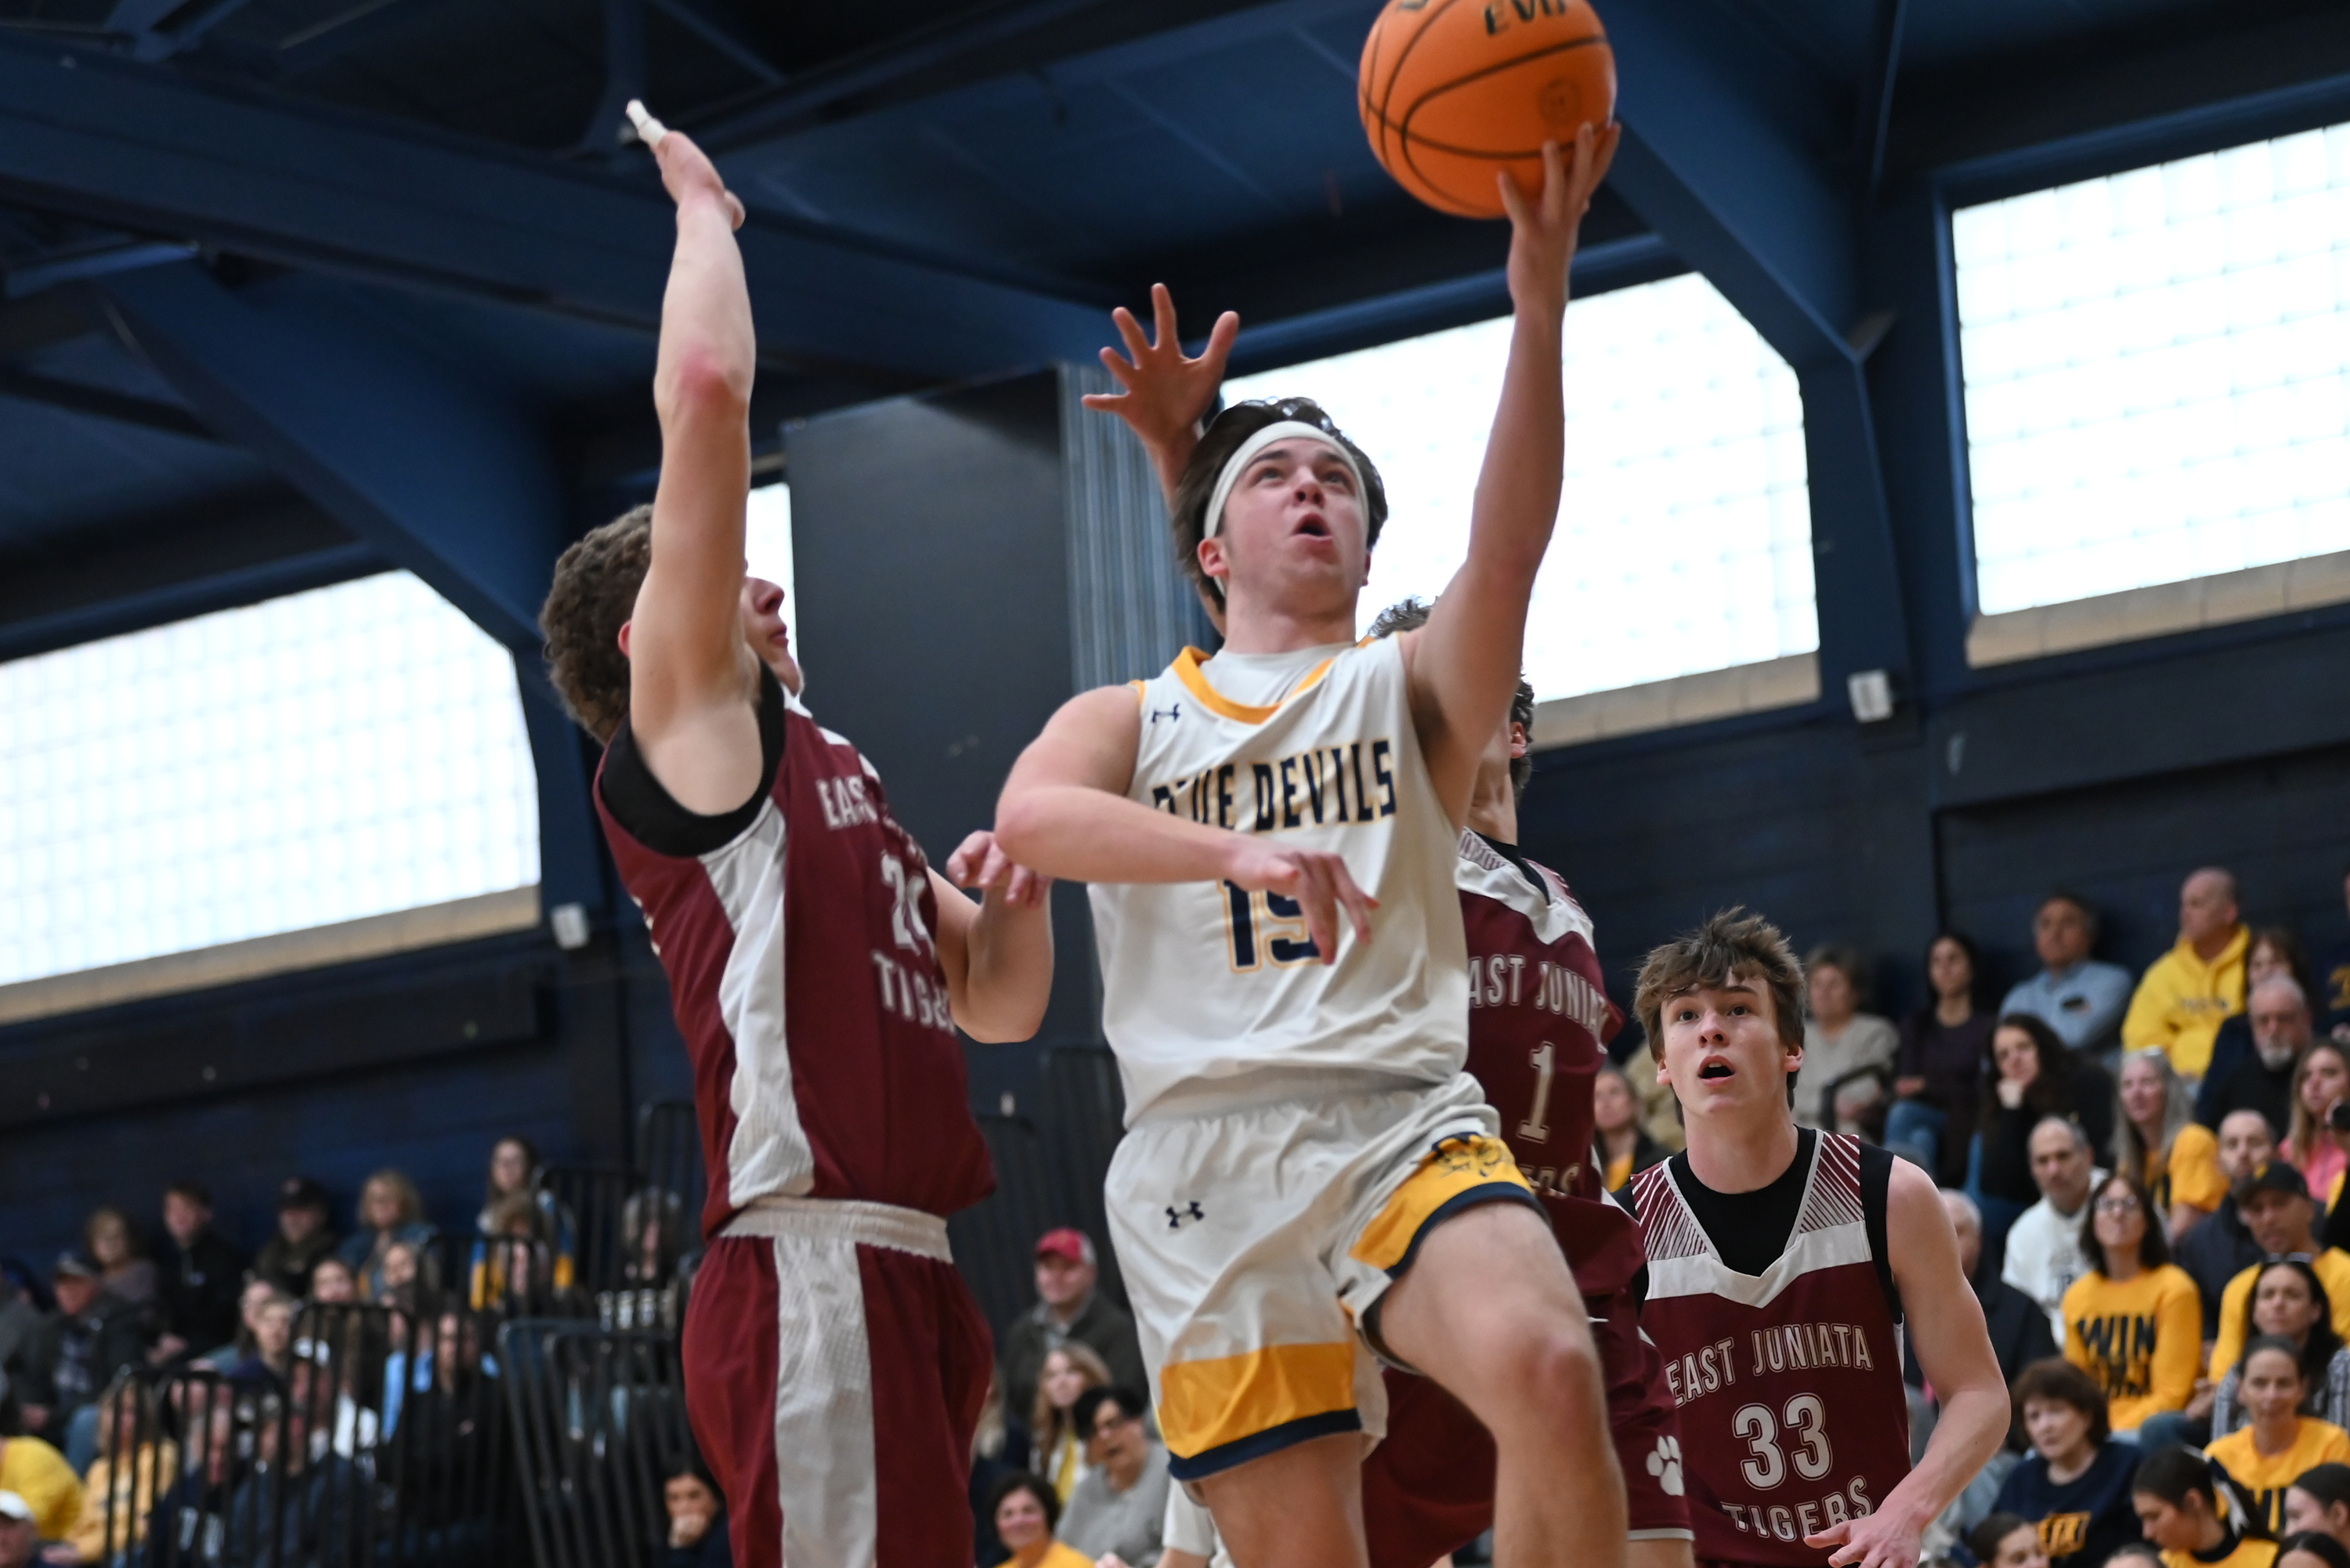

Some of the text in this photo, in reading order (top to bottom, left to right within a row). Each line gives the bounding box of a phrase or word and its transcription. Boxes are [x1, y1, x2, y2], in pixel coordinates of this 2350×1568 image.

[1150, 738, 1397, 835] UE DEVILS
[1469, 954, 1525, 1009] AST
[1517, 1040, 1555, 1144] 1
[1665, 1322, 1874, 1408] EAST JUNIATA
[1732, 1392, 1833, 1491] 33
[1720, 1476, 1873, 1542] TIGERS
